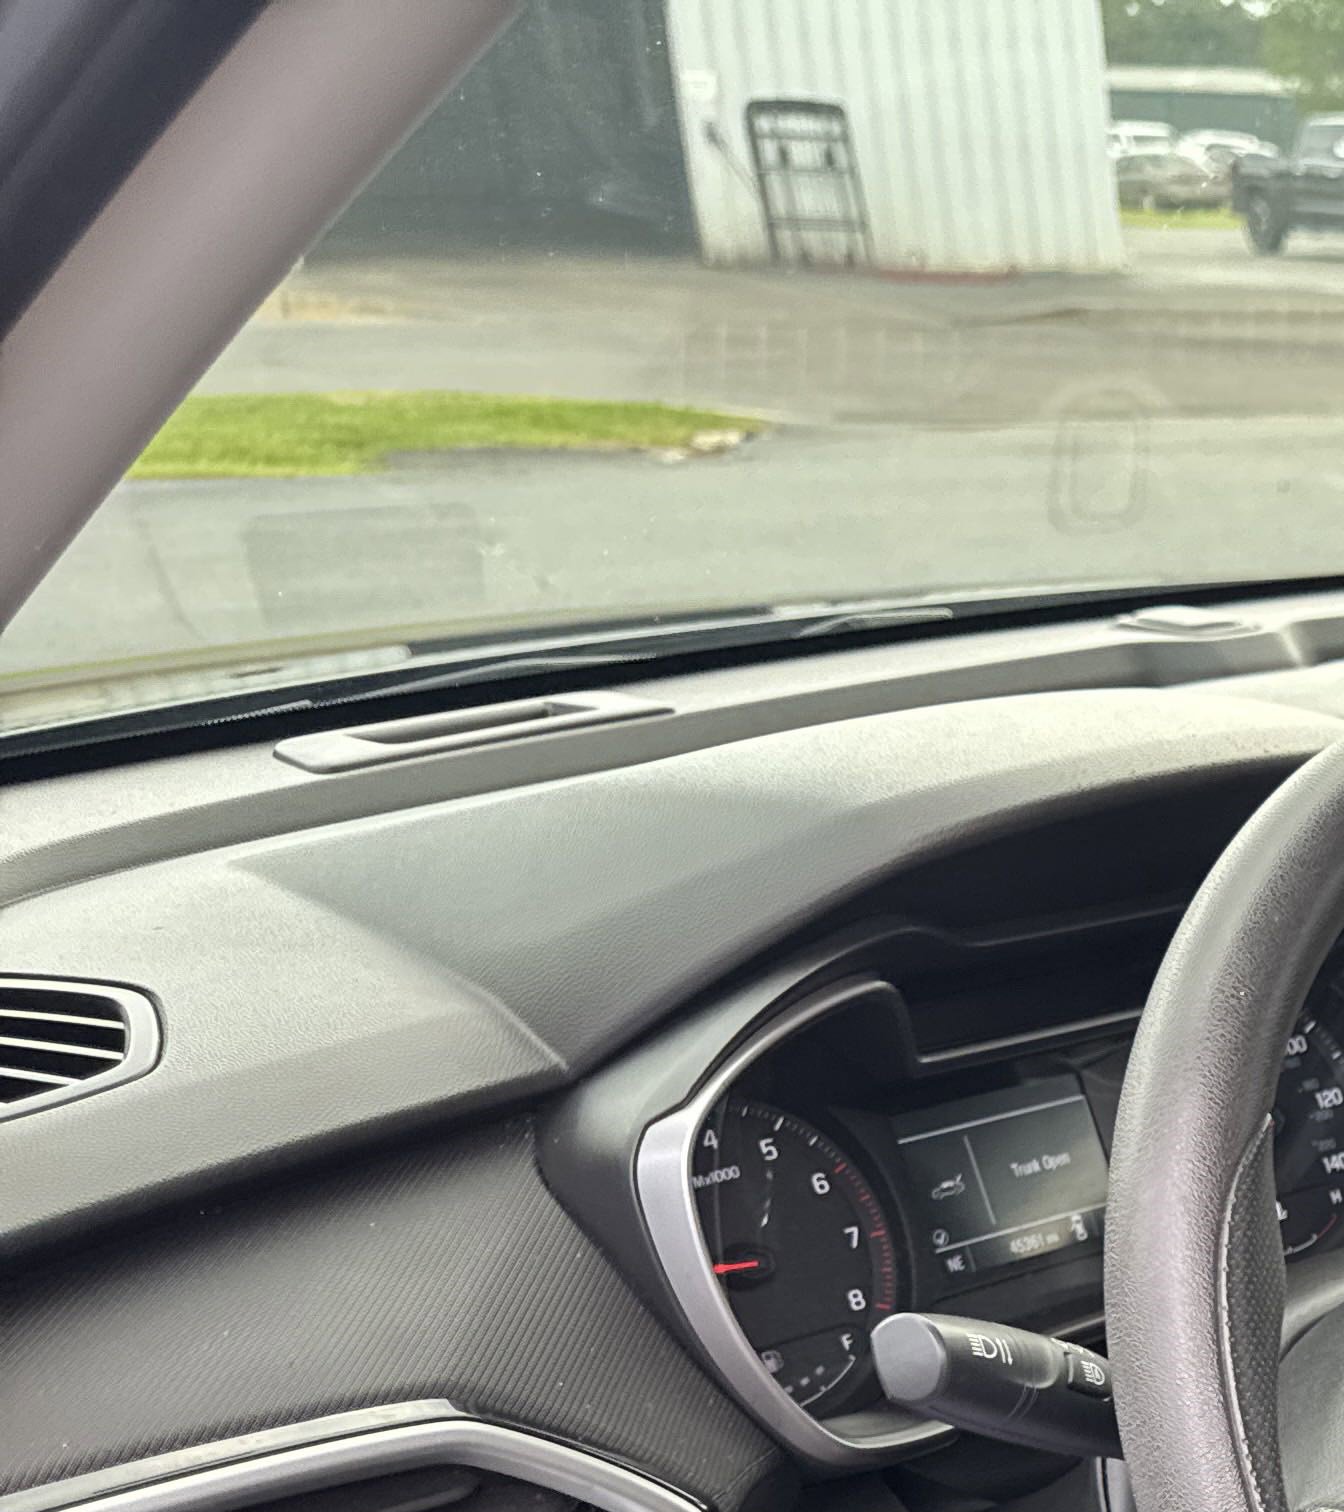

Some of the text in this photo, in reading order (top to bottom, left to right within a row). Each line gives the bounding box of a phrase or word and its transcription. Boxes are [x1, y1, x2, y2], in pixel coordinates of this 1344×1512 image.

[1286, 1035, 1308, 1055] 00
[1315, 1087, 1344, 1109] 120
[703, 1129, 718, 1149] 4
[759, 1138, 778, 1161] 5
[1010, 1152, 1071, 1178] Trunk Open
[811, 1172, 830, 1195] 6
[843, 1226, 859, 1249] 7
[946, 1254, 966, 1272] NE
[847, 1288, 867, 1311] 8
[840, 1333, 853, 1351] F
